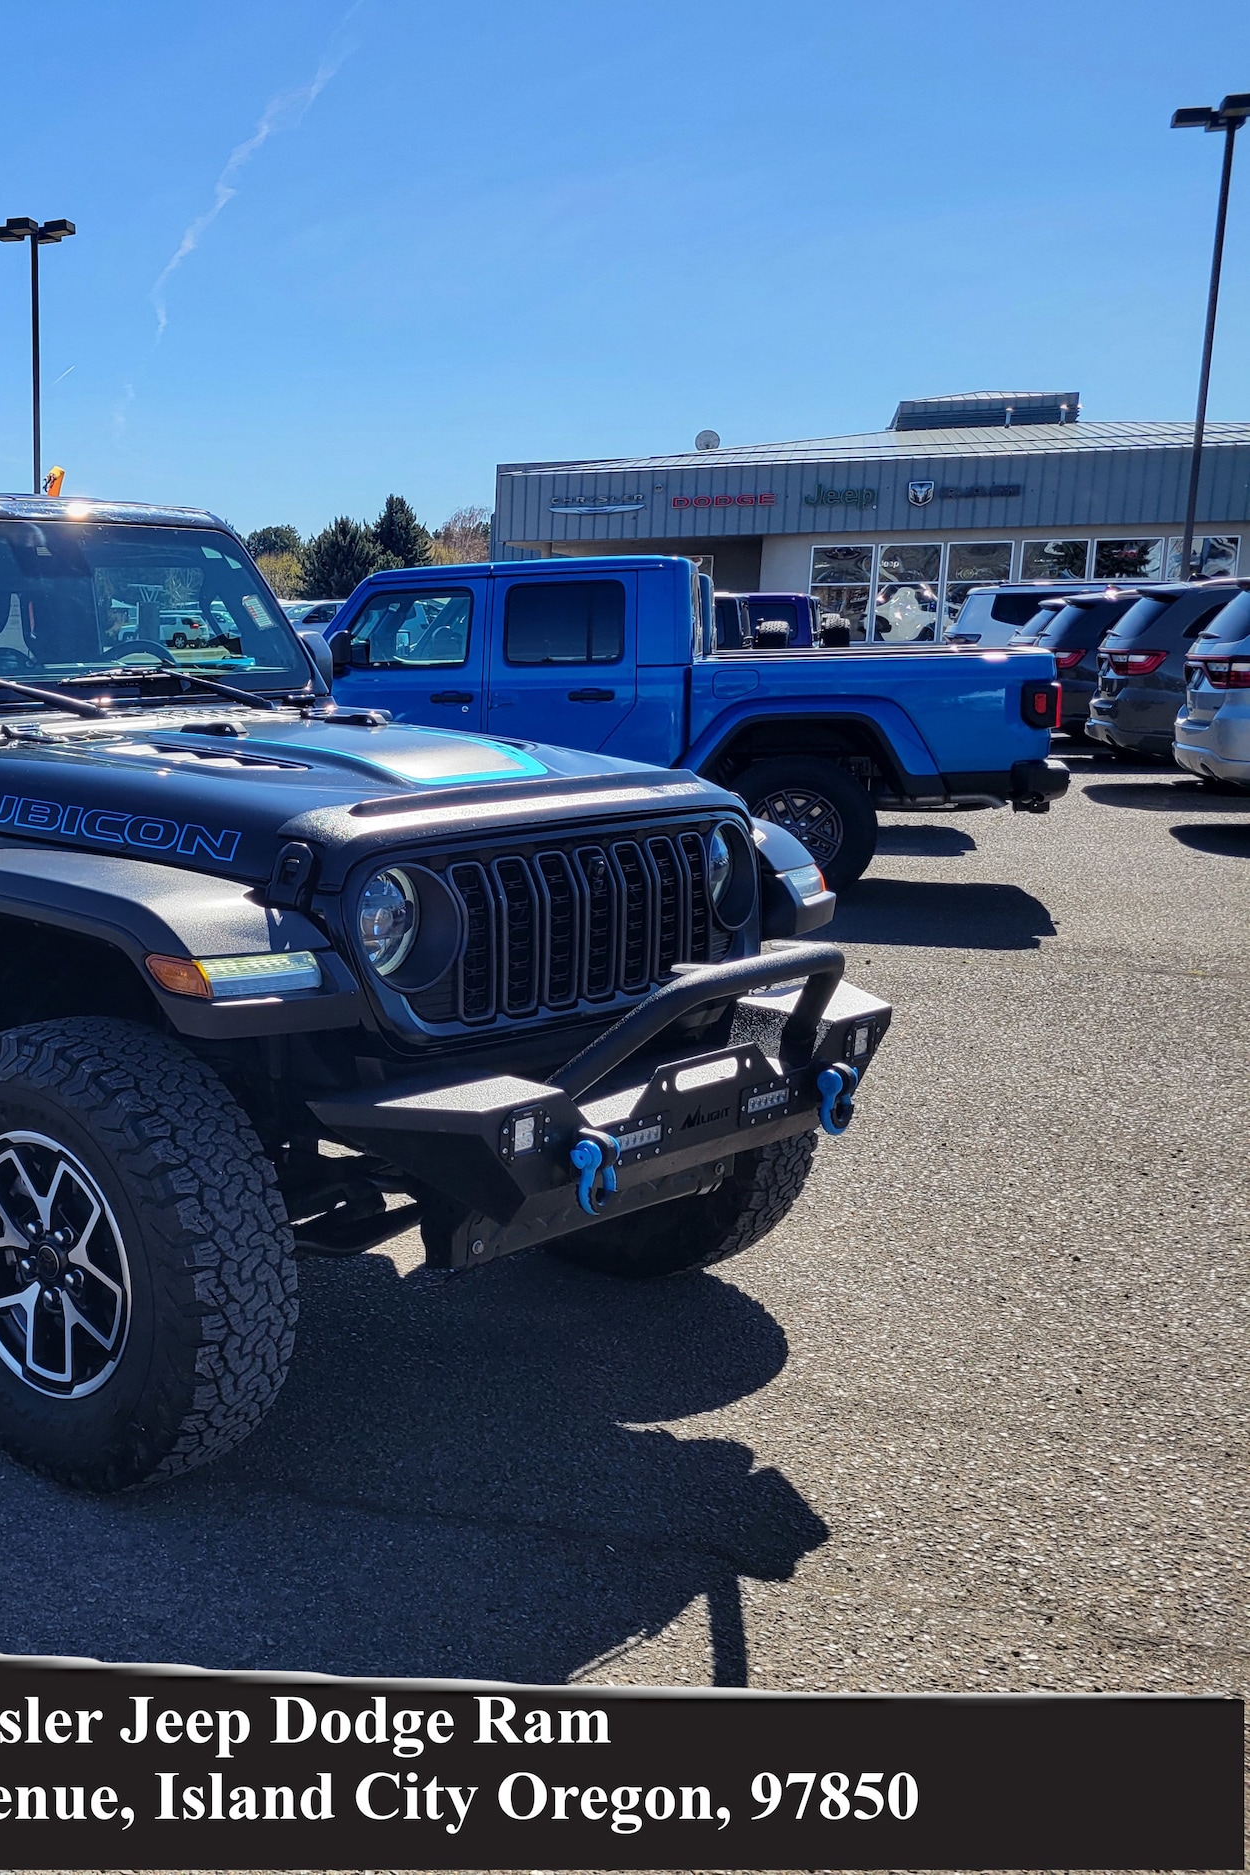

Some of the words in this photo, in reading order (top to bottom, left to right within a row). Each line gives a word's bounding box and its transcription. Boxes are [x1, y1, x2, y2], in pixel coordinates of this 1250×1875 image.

[551, 494, 644, 504] CHRYSLER
[804, 483, 877, 509] Jeep
[939, 484, 1021, 499] RAM
[671, 493, 777, 509] DODGE
